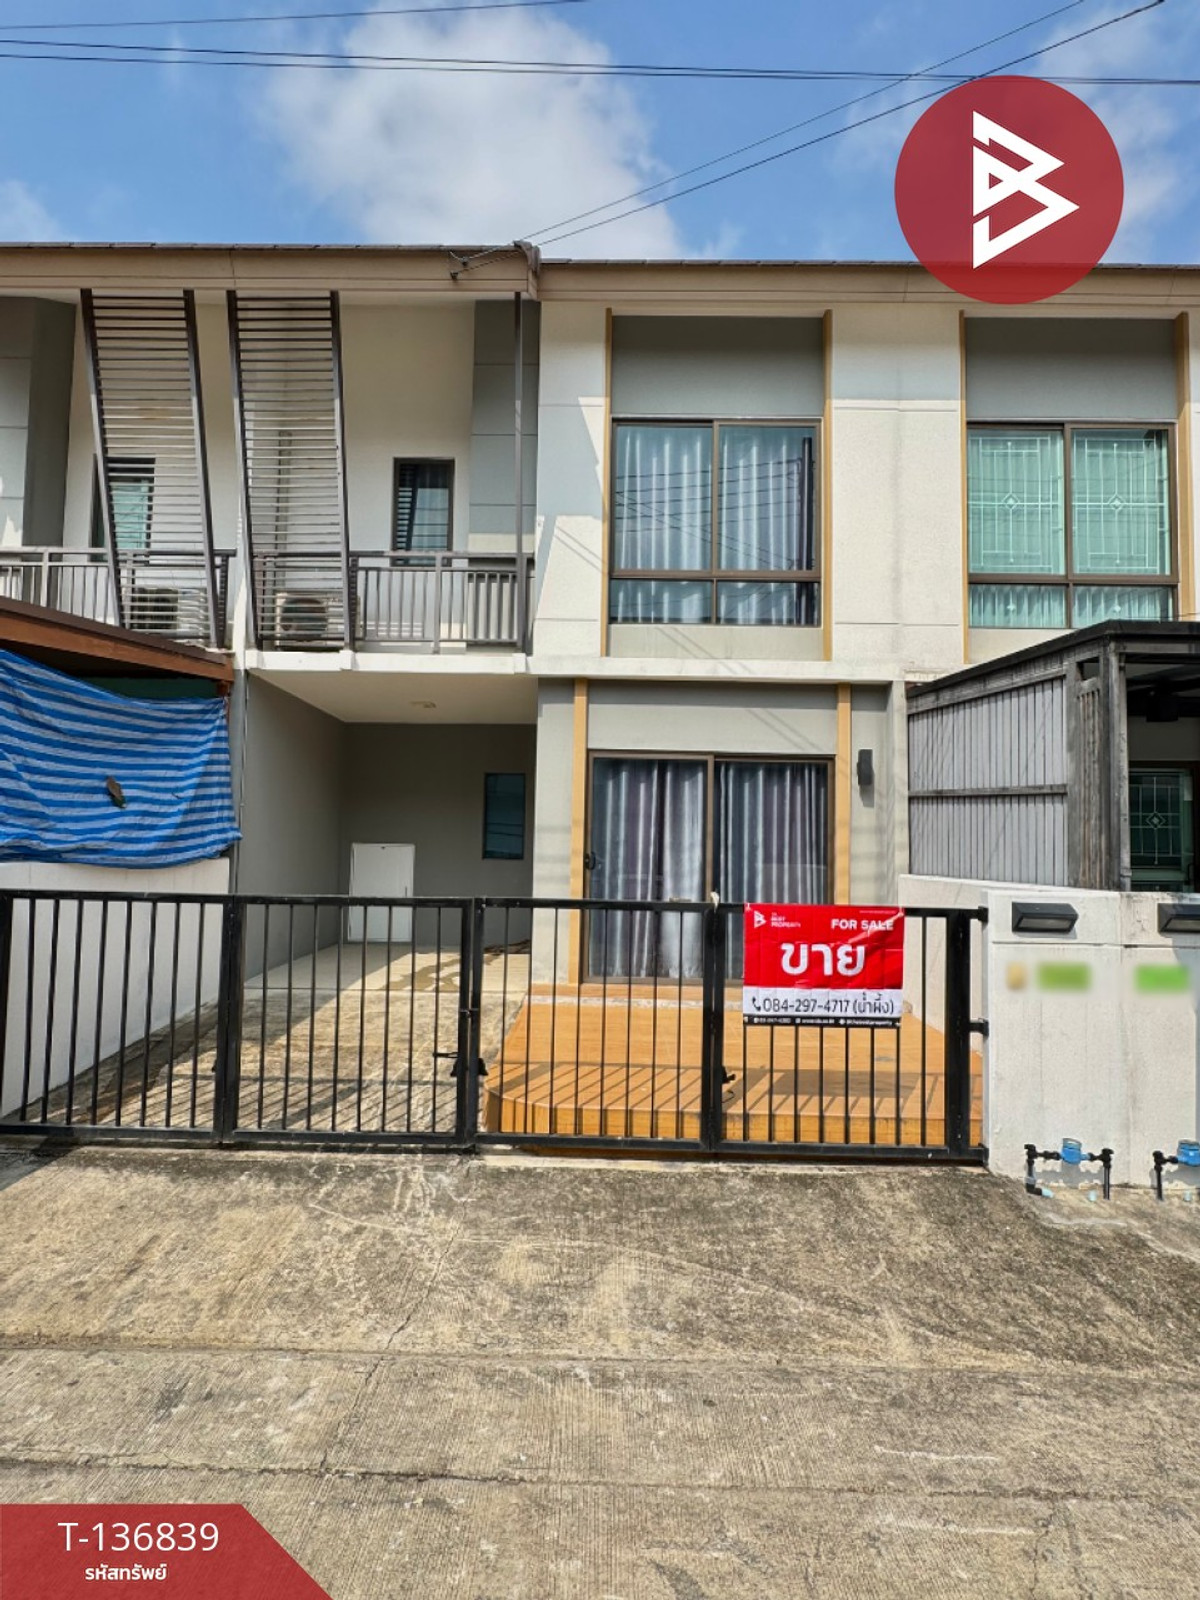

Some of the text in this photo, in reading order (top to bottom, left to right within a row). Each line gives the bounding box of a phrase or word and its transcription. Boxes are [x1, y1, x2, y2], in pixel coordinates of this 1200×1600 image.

[831, 918, 894, 931] FOR SALE
[781, 942, 866, 977] ขาย
[763, 998, 850, 1013] 084-297-4717
